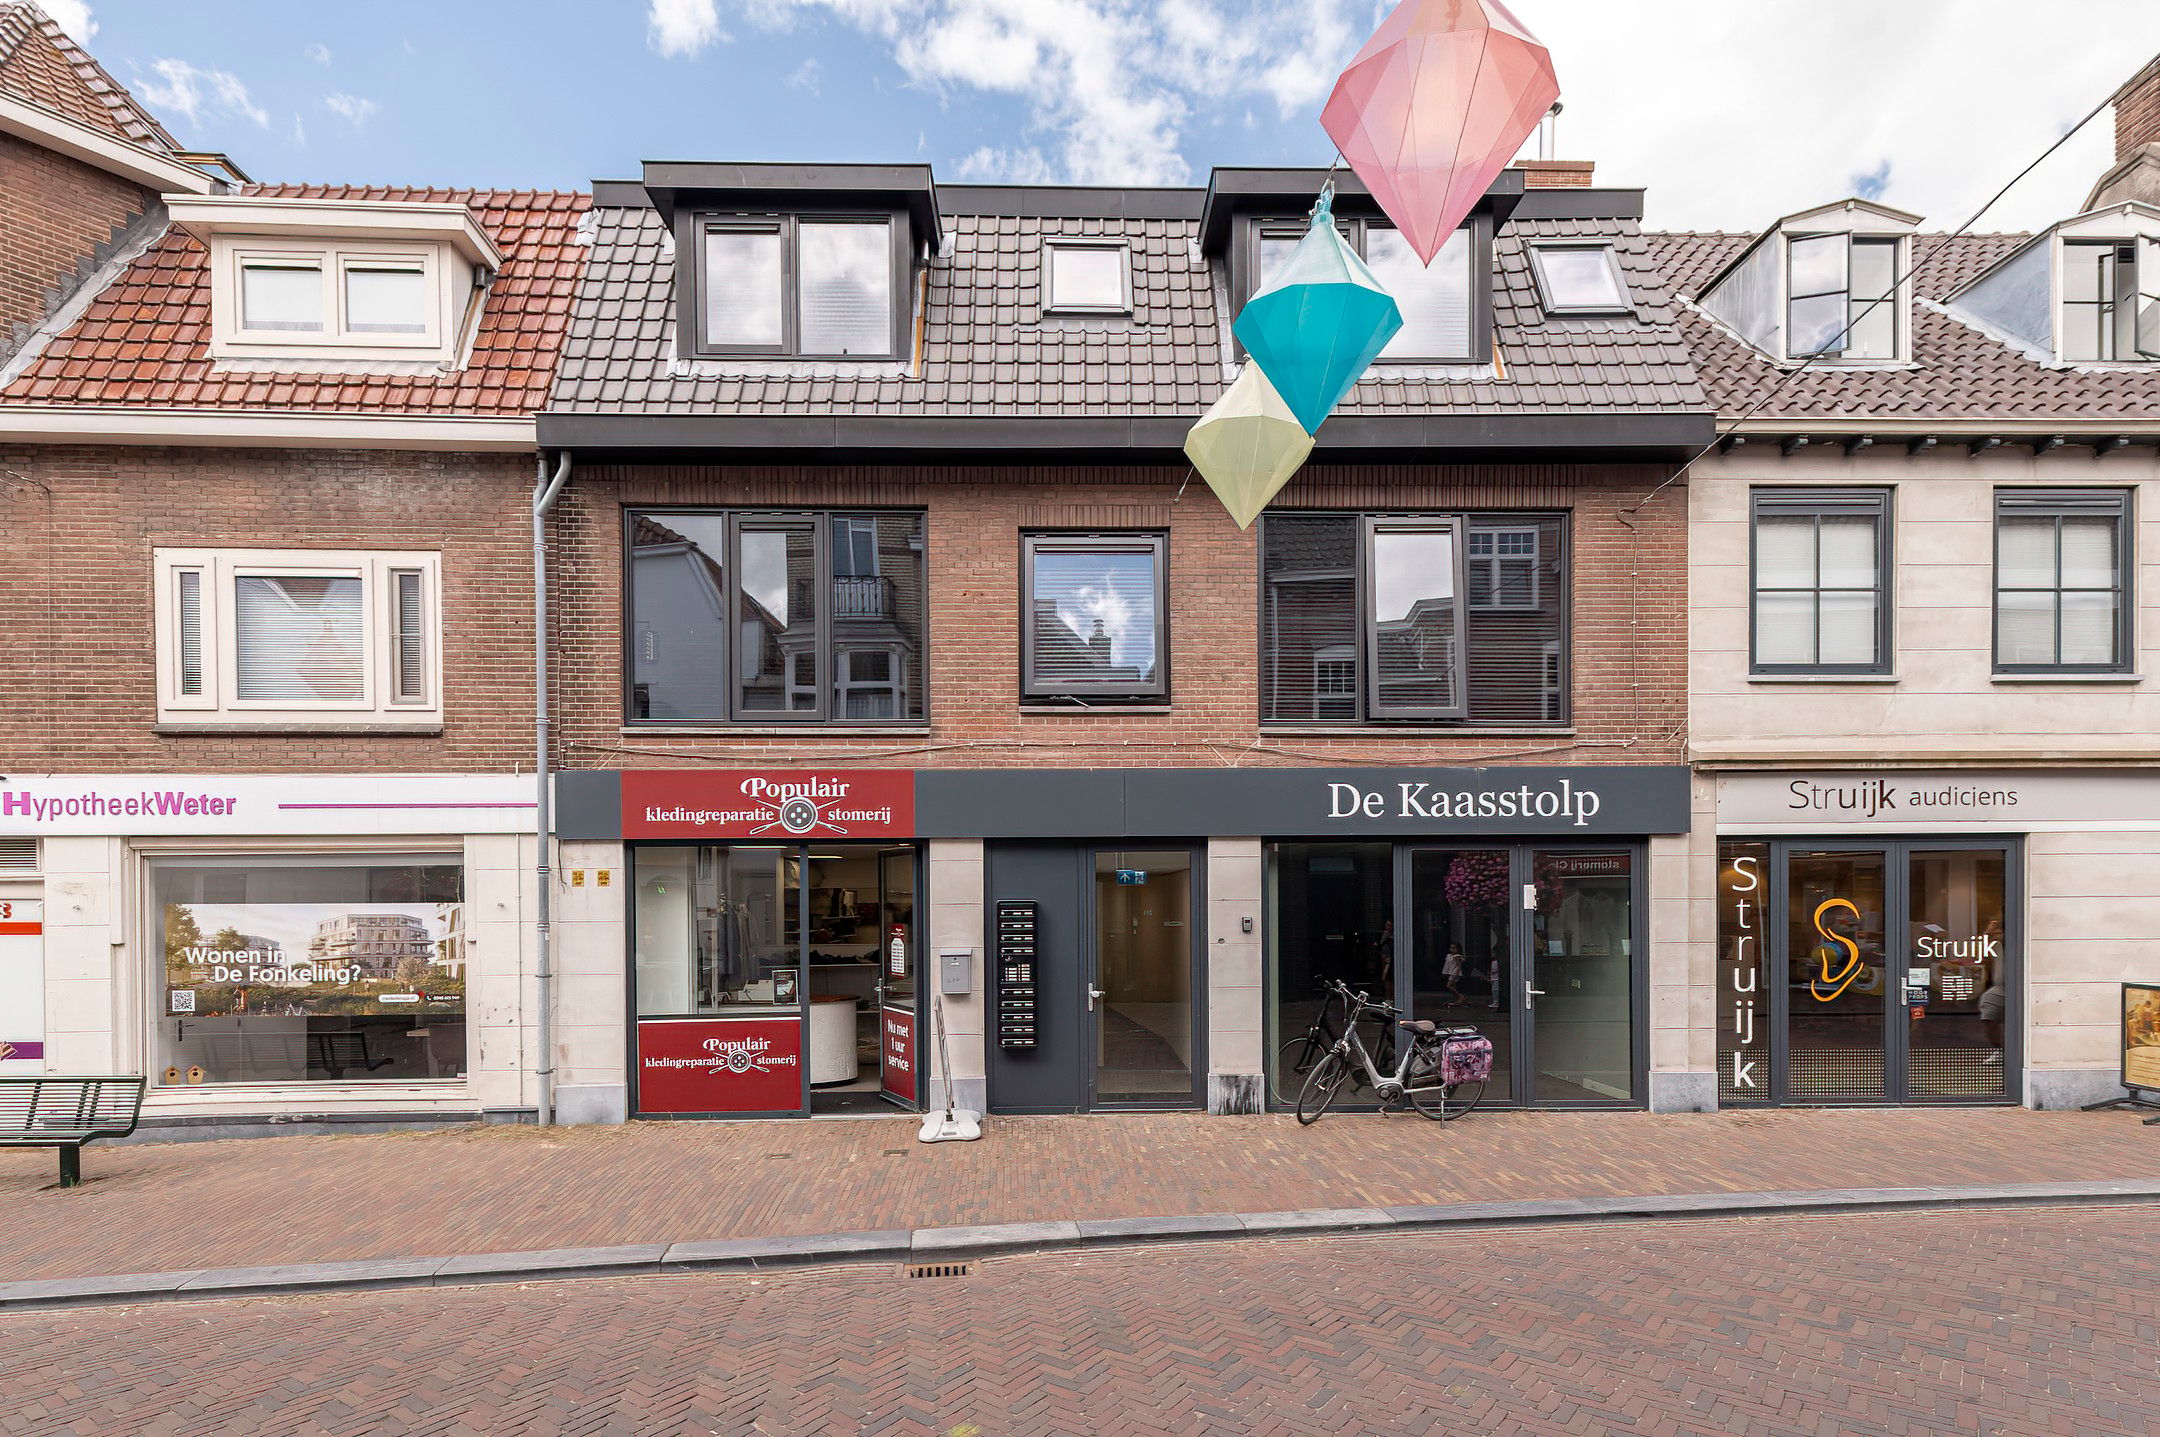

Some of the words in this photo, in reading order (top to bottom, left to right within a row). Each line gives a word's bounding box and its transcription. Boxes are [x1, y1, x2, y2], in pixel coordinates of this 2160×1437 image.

[740, 776, 850, 801] Populair
[3, 791, 237, 821] HypotheekWeter
[1327, 782, 1385, 818] De
[1397, 779, 1601, 826] Kaasstolp
[1788, 780, 1897, 818] Struijk
[1909, 786, 2018, 808] audiciens
[645, 806, 775, 825] kledingreparatie
[827, 806, 892, 824] stomerij
[185, 947, 261, 964] Wonen
[267, 946, 287, 963] in
[1917, 934, 1998, 964] Struijk
[214, 966, 243, 983] De
[249, 964, 361, 985] Fonkeling?
[1732, 856, 1758, 1088] Struijk
[887, 1019, 896, 1034] Nu
[896, 1024, 909, 1038] met
[702, 1037, 771, 1053] Populair
[891, 1036, 895, 1050] 1
[895, 1041, 906, 1053] uur
[645, 1057, 725, 1068] kledingreparatie
[757, 1055, 797, 1066] stomerij
[888, 1055, 909, 1072] service
